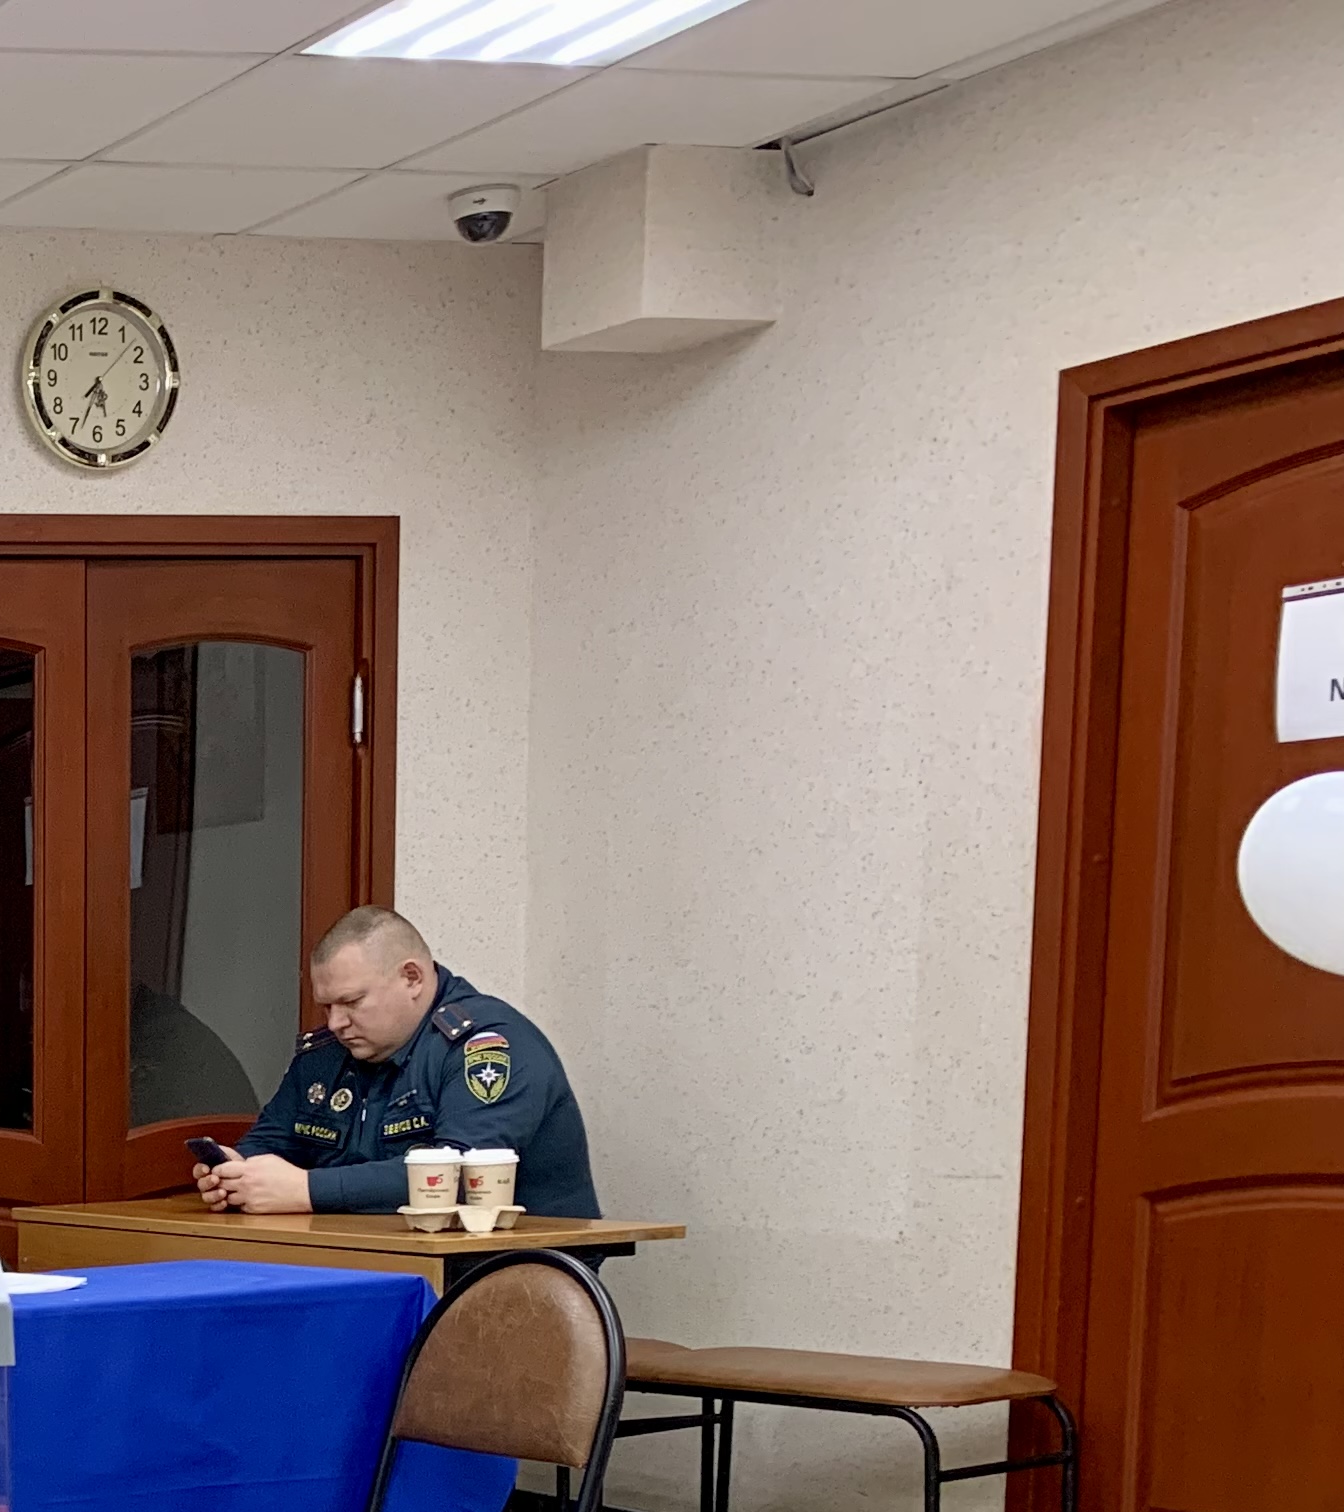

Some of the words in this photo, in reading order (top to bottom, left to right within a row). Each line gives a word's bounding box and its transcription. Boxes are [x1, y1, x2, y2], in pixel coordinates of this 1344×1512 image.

[69, 323, 83, 342] 11
[89, 316, 109, 336] 12
[117, 325, 126, 344] 1
[50, 343, 68, 361] 10
[132, 345, 144, 364] 2
[47, 369, 58, 387] 9
[138, 372, 149, 391] 3
[53, 397, 63, 415] 8
[131, 400, 143, 418] 4
[69, 418, 80, 435] 7
[92, 425, 103, 443] 6
[115, 419, 126, 437] 5
